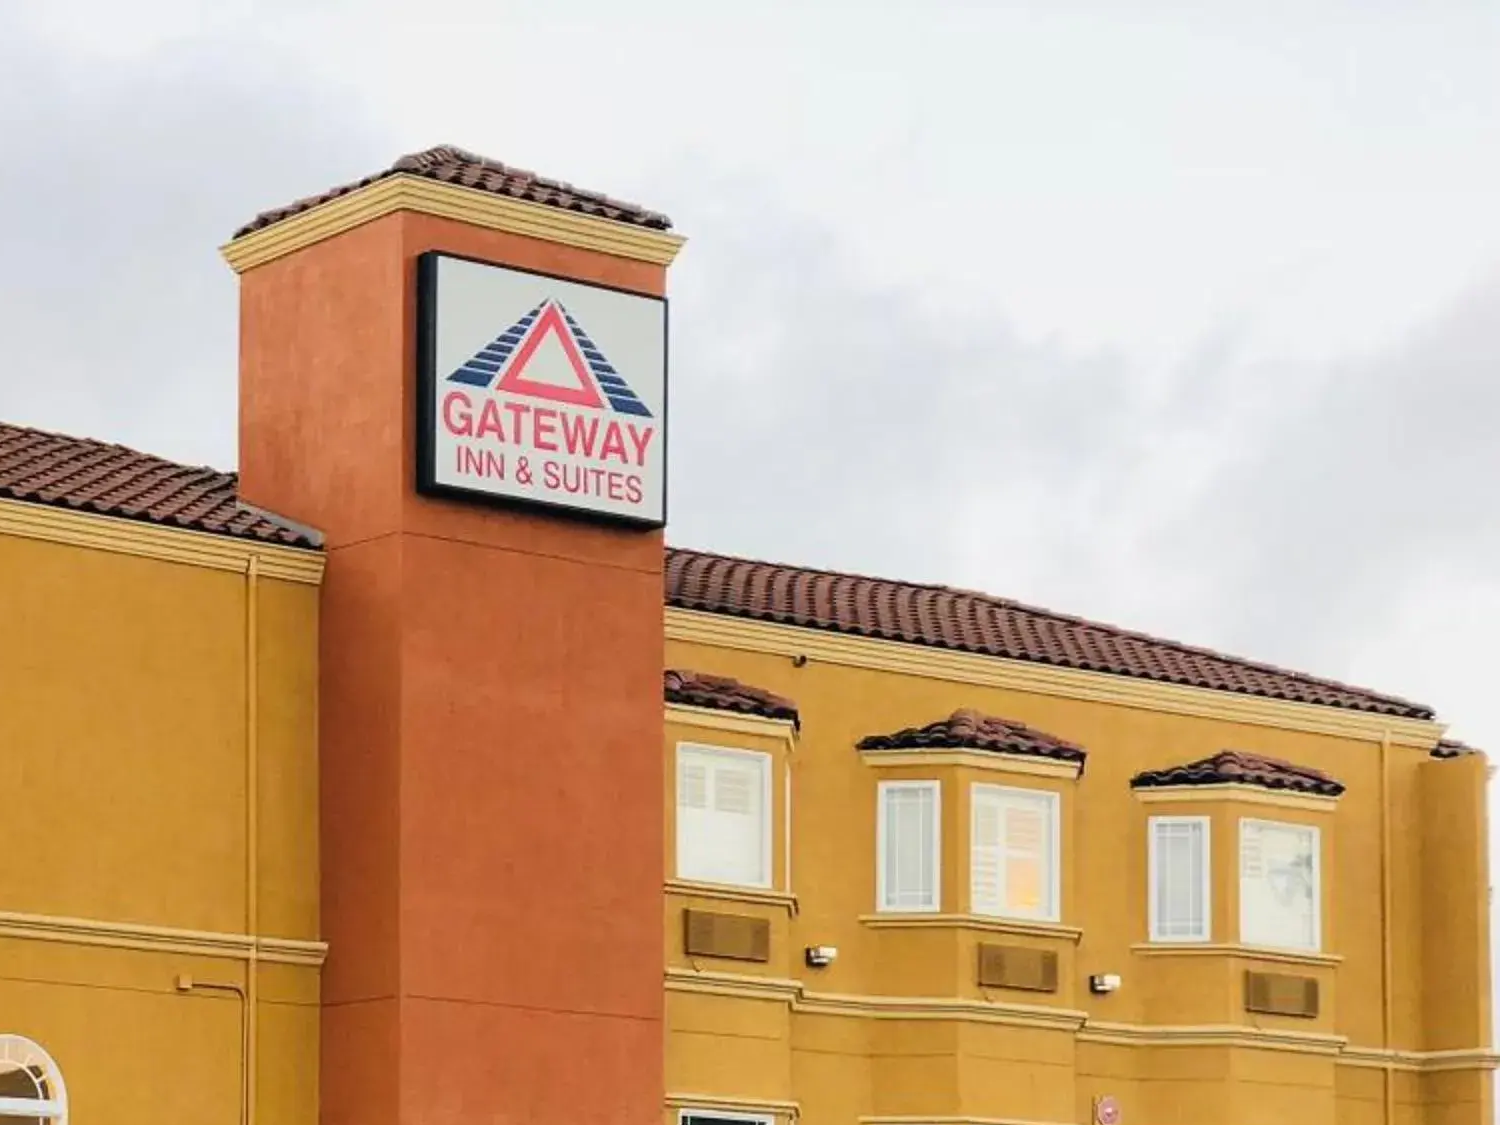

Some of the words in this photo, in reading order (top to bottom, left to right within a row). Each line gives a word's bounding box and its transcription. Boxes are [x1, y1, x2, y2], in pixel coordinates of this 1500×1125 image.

[442, 391, 654, 467] GATEWAY
[456, 445, 505, 481] INN
[515, 456, 534, 486] &
[543, 460, 644, 504] SUITES
